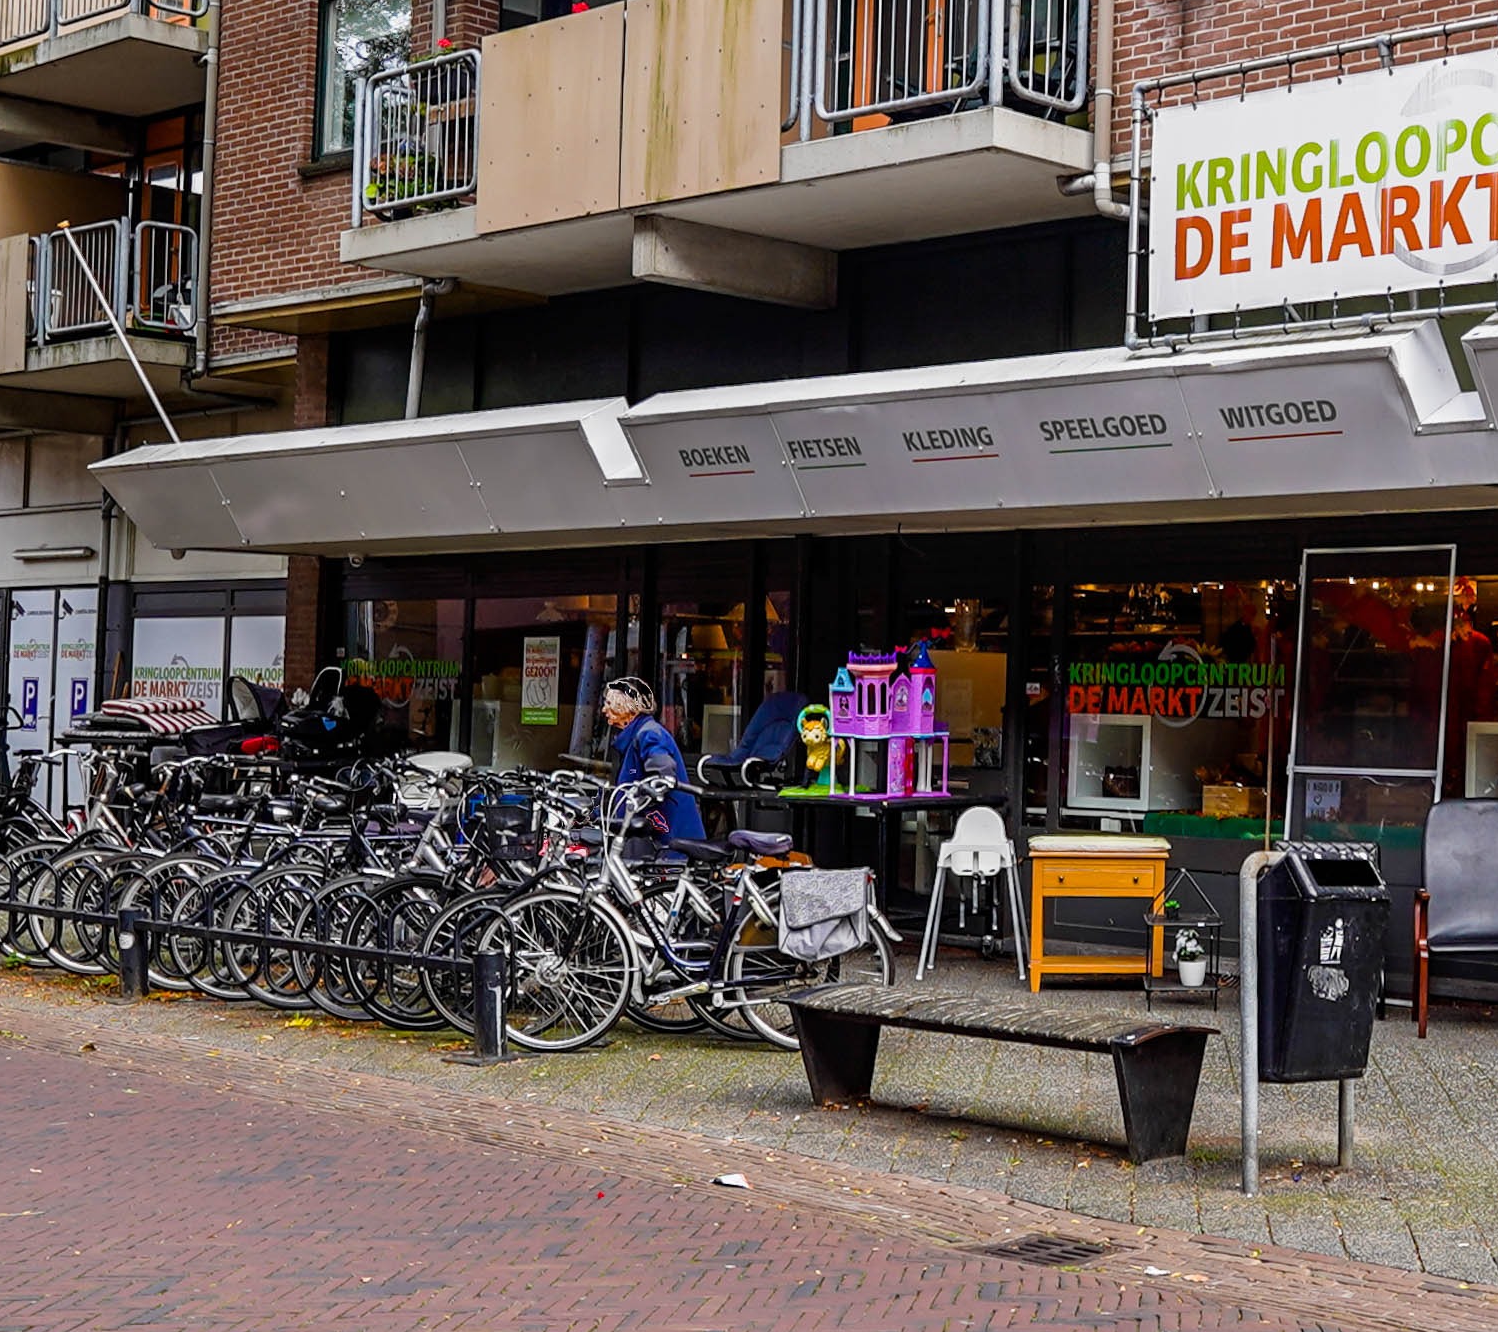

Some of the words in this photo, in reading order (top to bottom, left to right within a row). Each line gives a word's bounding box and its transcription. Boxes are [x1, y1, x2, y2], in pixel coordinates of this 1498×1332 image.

[1175, 208, 1252, 281] DE
[1218, 399, 1338, 430] WITGOED
[902, 424, 994, 452] KLEDING
[1039, 413, 1168, 442] SPEELGOED
[678, 444, 752, 468] BOEKEN
[786, 436, 863, 460] FIETSEN
[133, 666, 222, 681] KRINGLOOPCENTRUM
[233, 666, 284, 682] KRINGLOOP
[1069, 661, 1286, 687] KRINGLOOPCENTRUM
[133, 680, 147, 697] DE
[149, 680, 189, 699] MARKT
[188, 681, 221, 699] ZEIST
[416, 677, 459, 701] ZEIST
[1068, 685, 1101, 715] DE
[1106, 686, 1202, 717] MARKT
[1207, 686, 1286, 718] ZEIST
